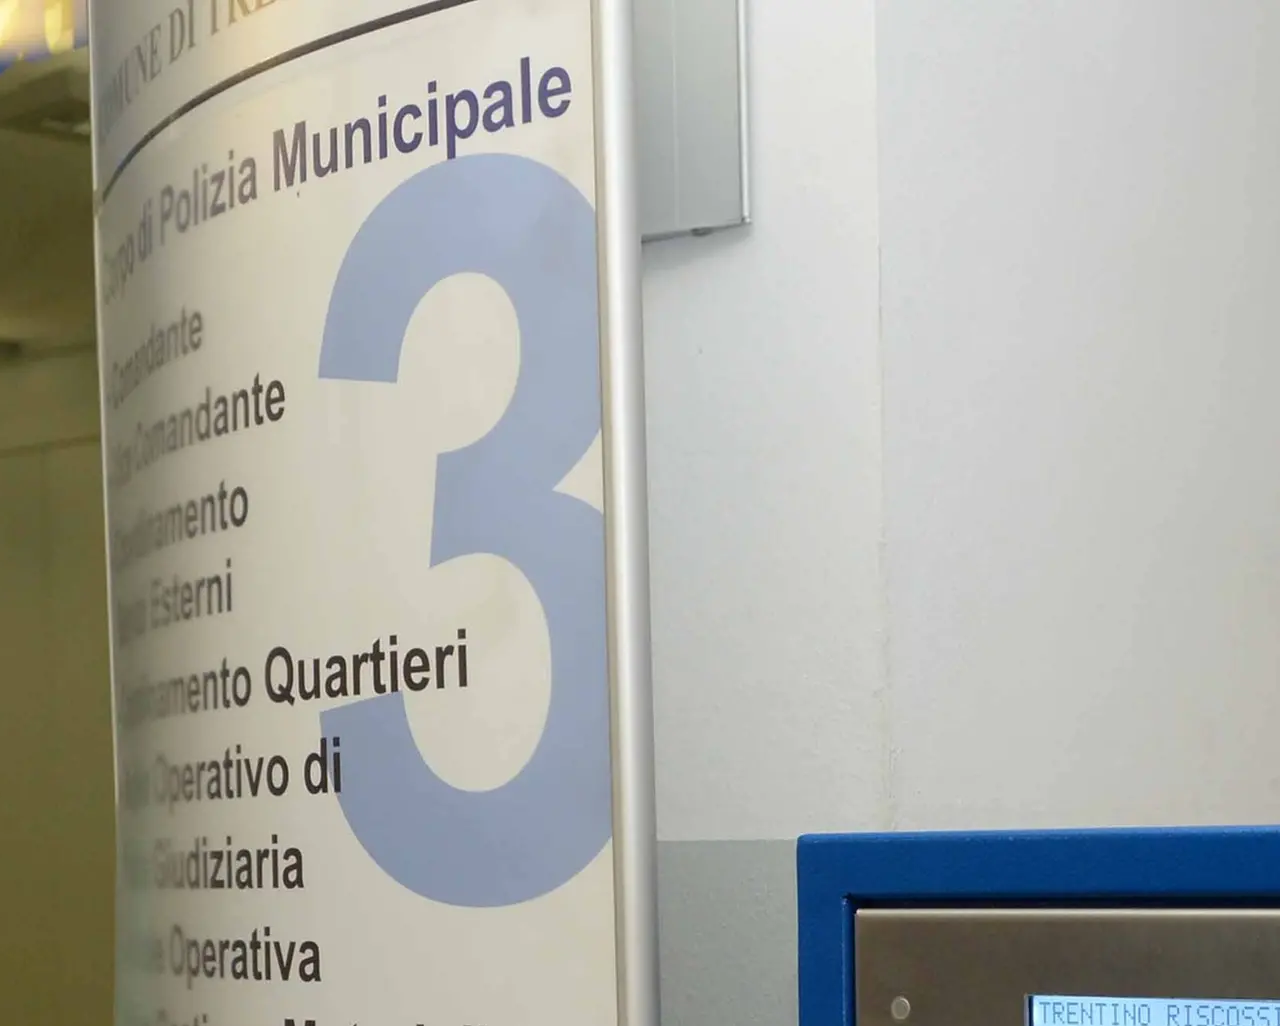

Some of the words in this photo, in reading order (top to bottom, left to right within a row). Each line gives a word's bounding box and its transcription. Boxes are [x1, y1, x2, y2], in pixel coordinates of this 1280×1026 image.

[160, 150, 258, 246] Polizia
[272, 57, 572, 192] Municipale
[150, 557, 233, 630] Esterni
[264, 628, 469, 706] Quartieri
[153, 744, 290, 815] Operativo
[304, 736, 342, 794] di
[170, 922, 322, 990] Operativa
